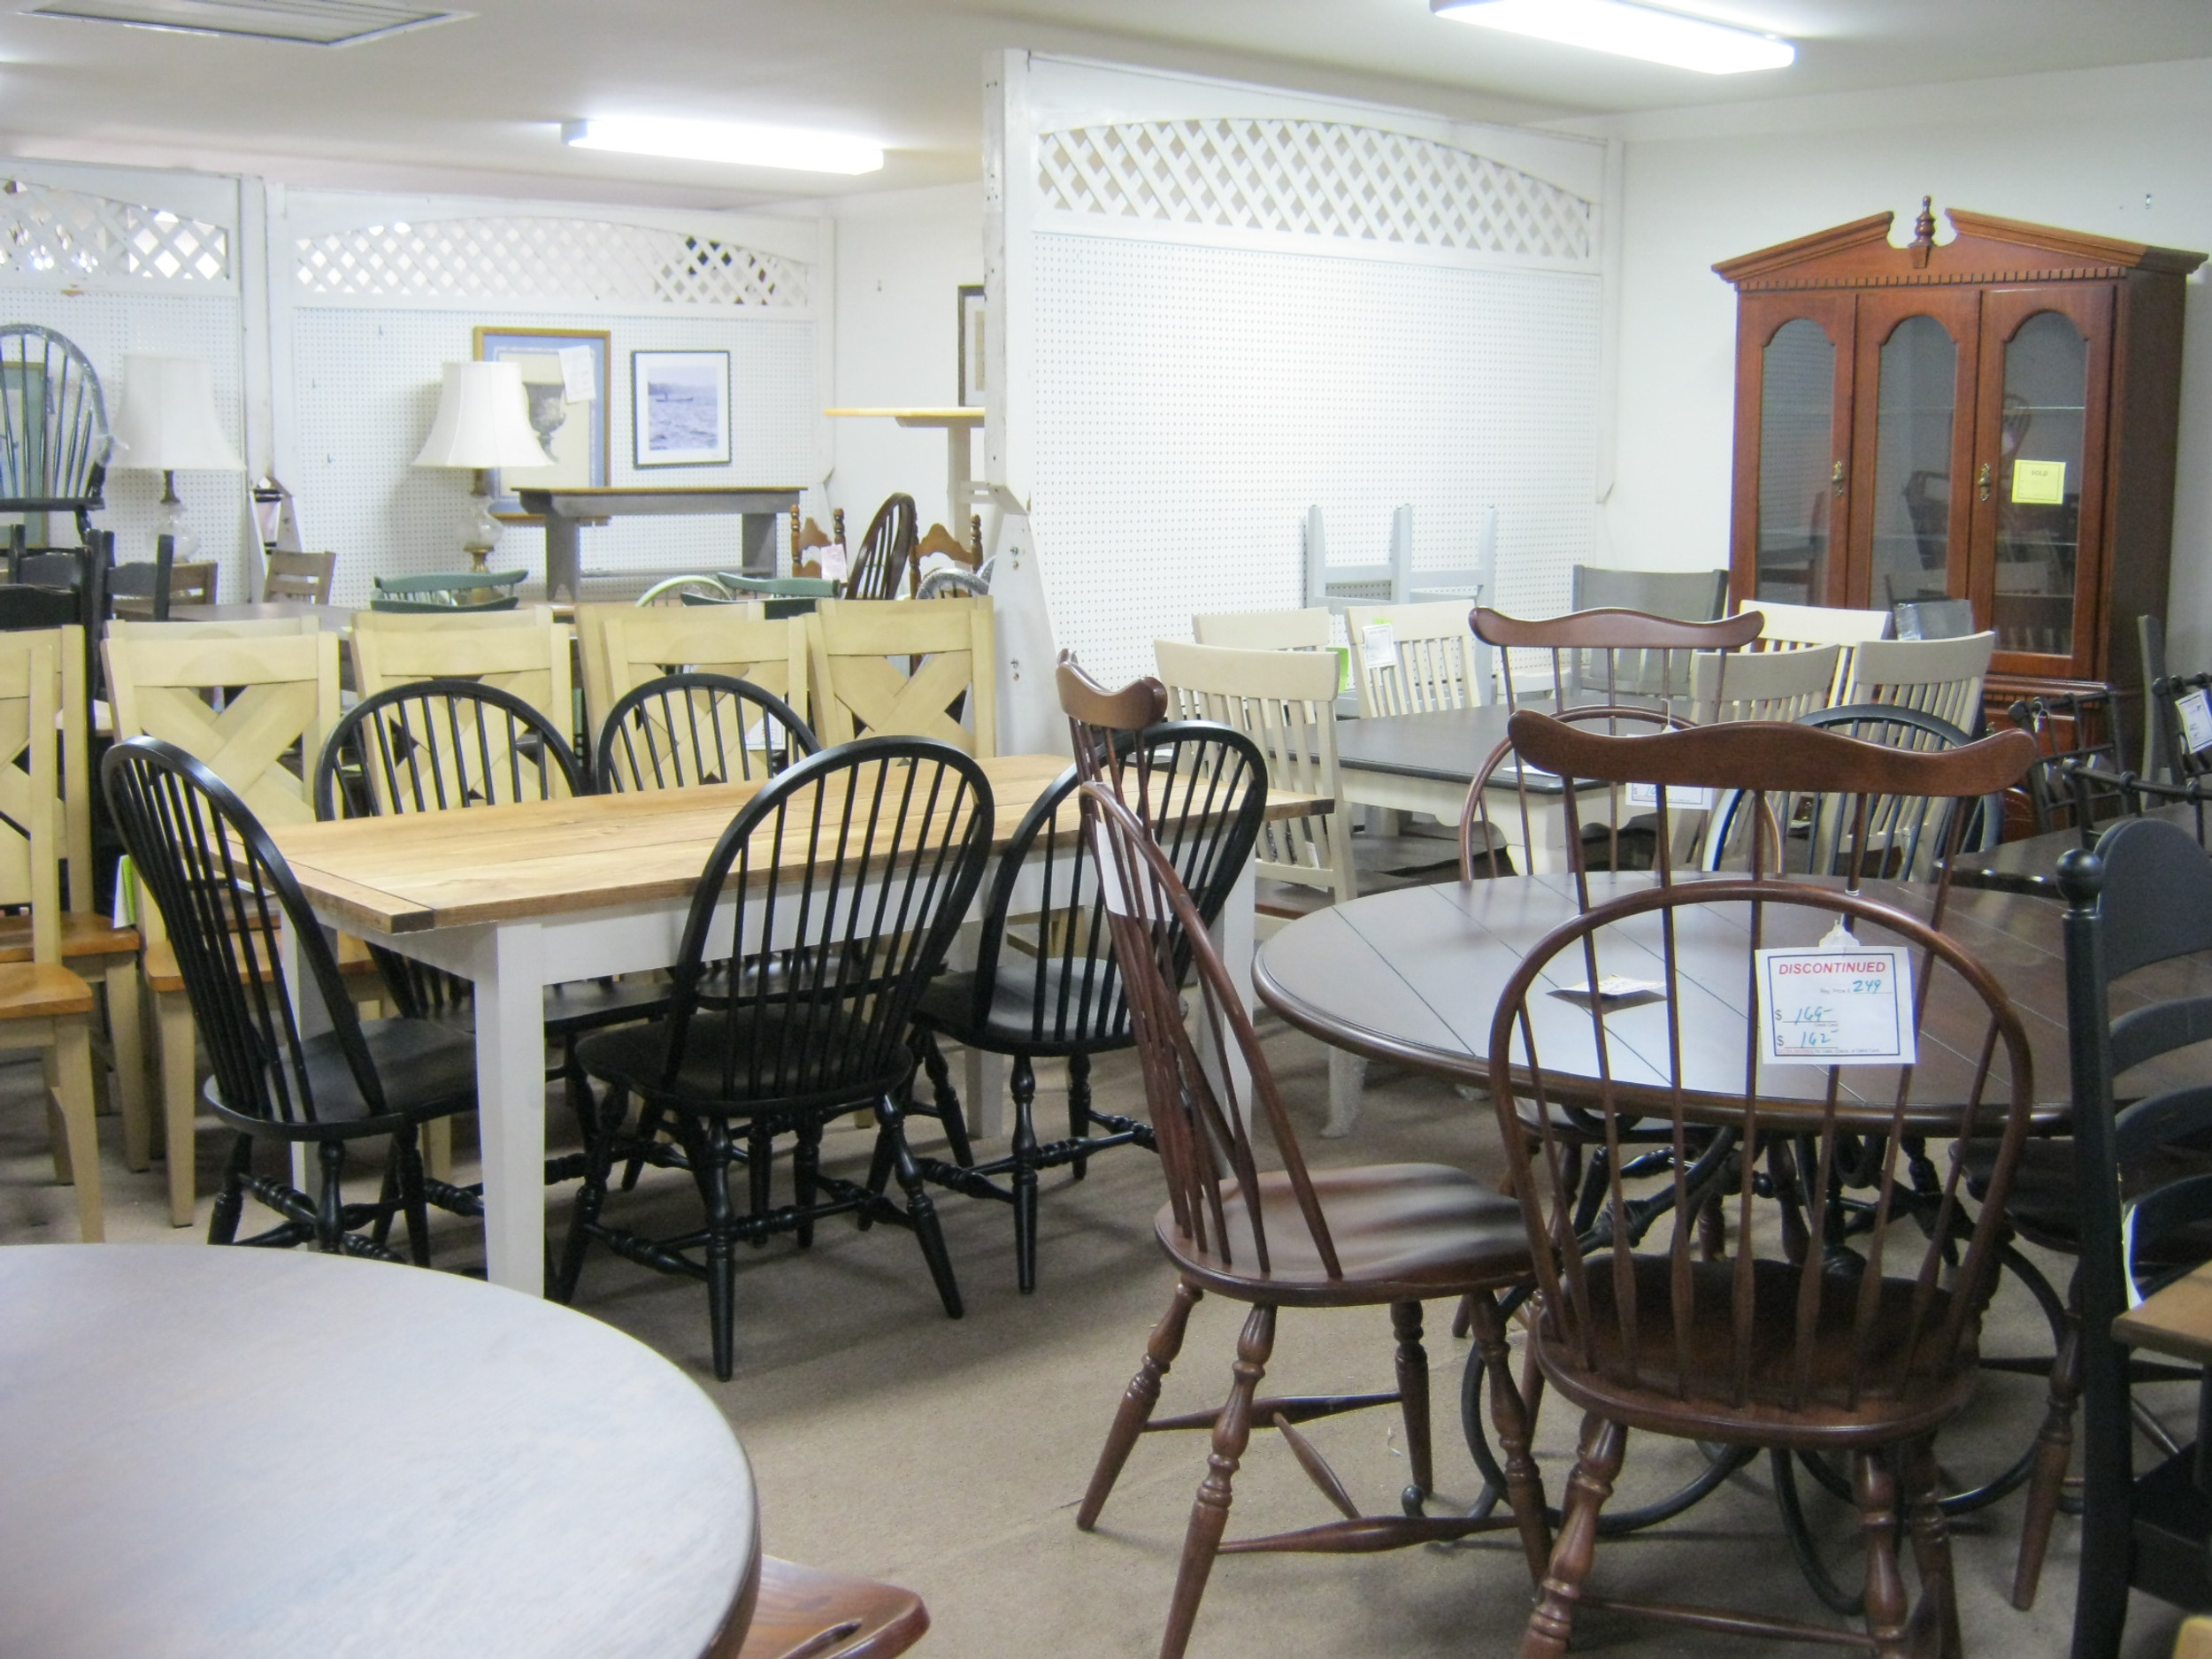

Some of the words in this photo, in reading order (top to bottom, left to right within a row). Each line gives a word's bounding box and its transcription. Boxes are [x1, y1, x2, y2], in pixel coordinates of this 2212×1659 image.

[1778, 962, 1886, 975] DISCONTINUED
[1853, 979, 1881, 994] 249
[1775, 1009, 1783, 1021] $
[1777, 1035, 1785, 1047] $
